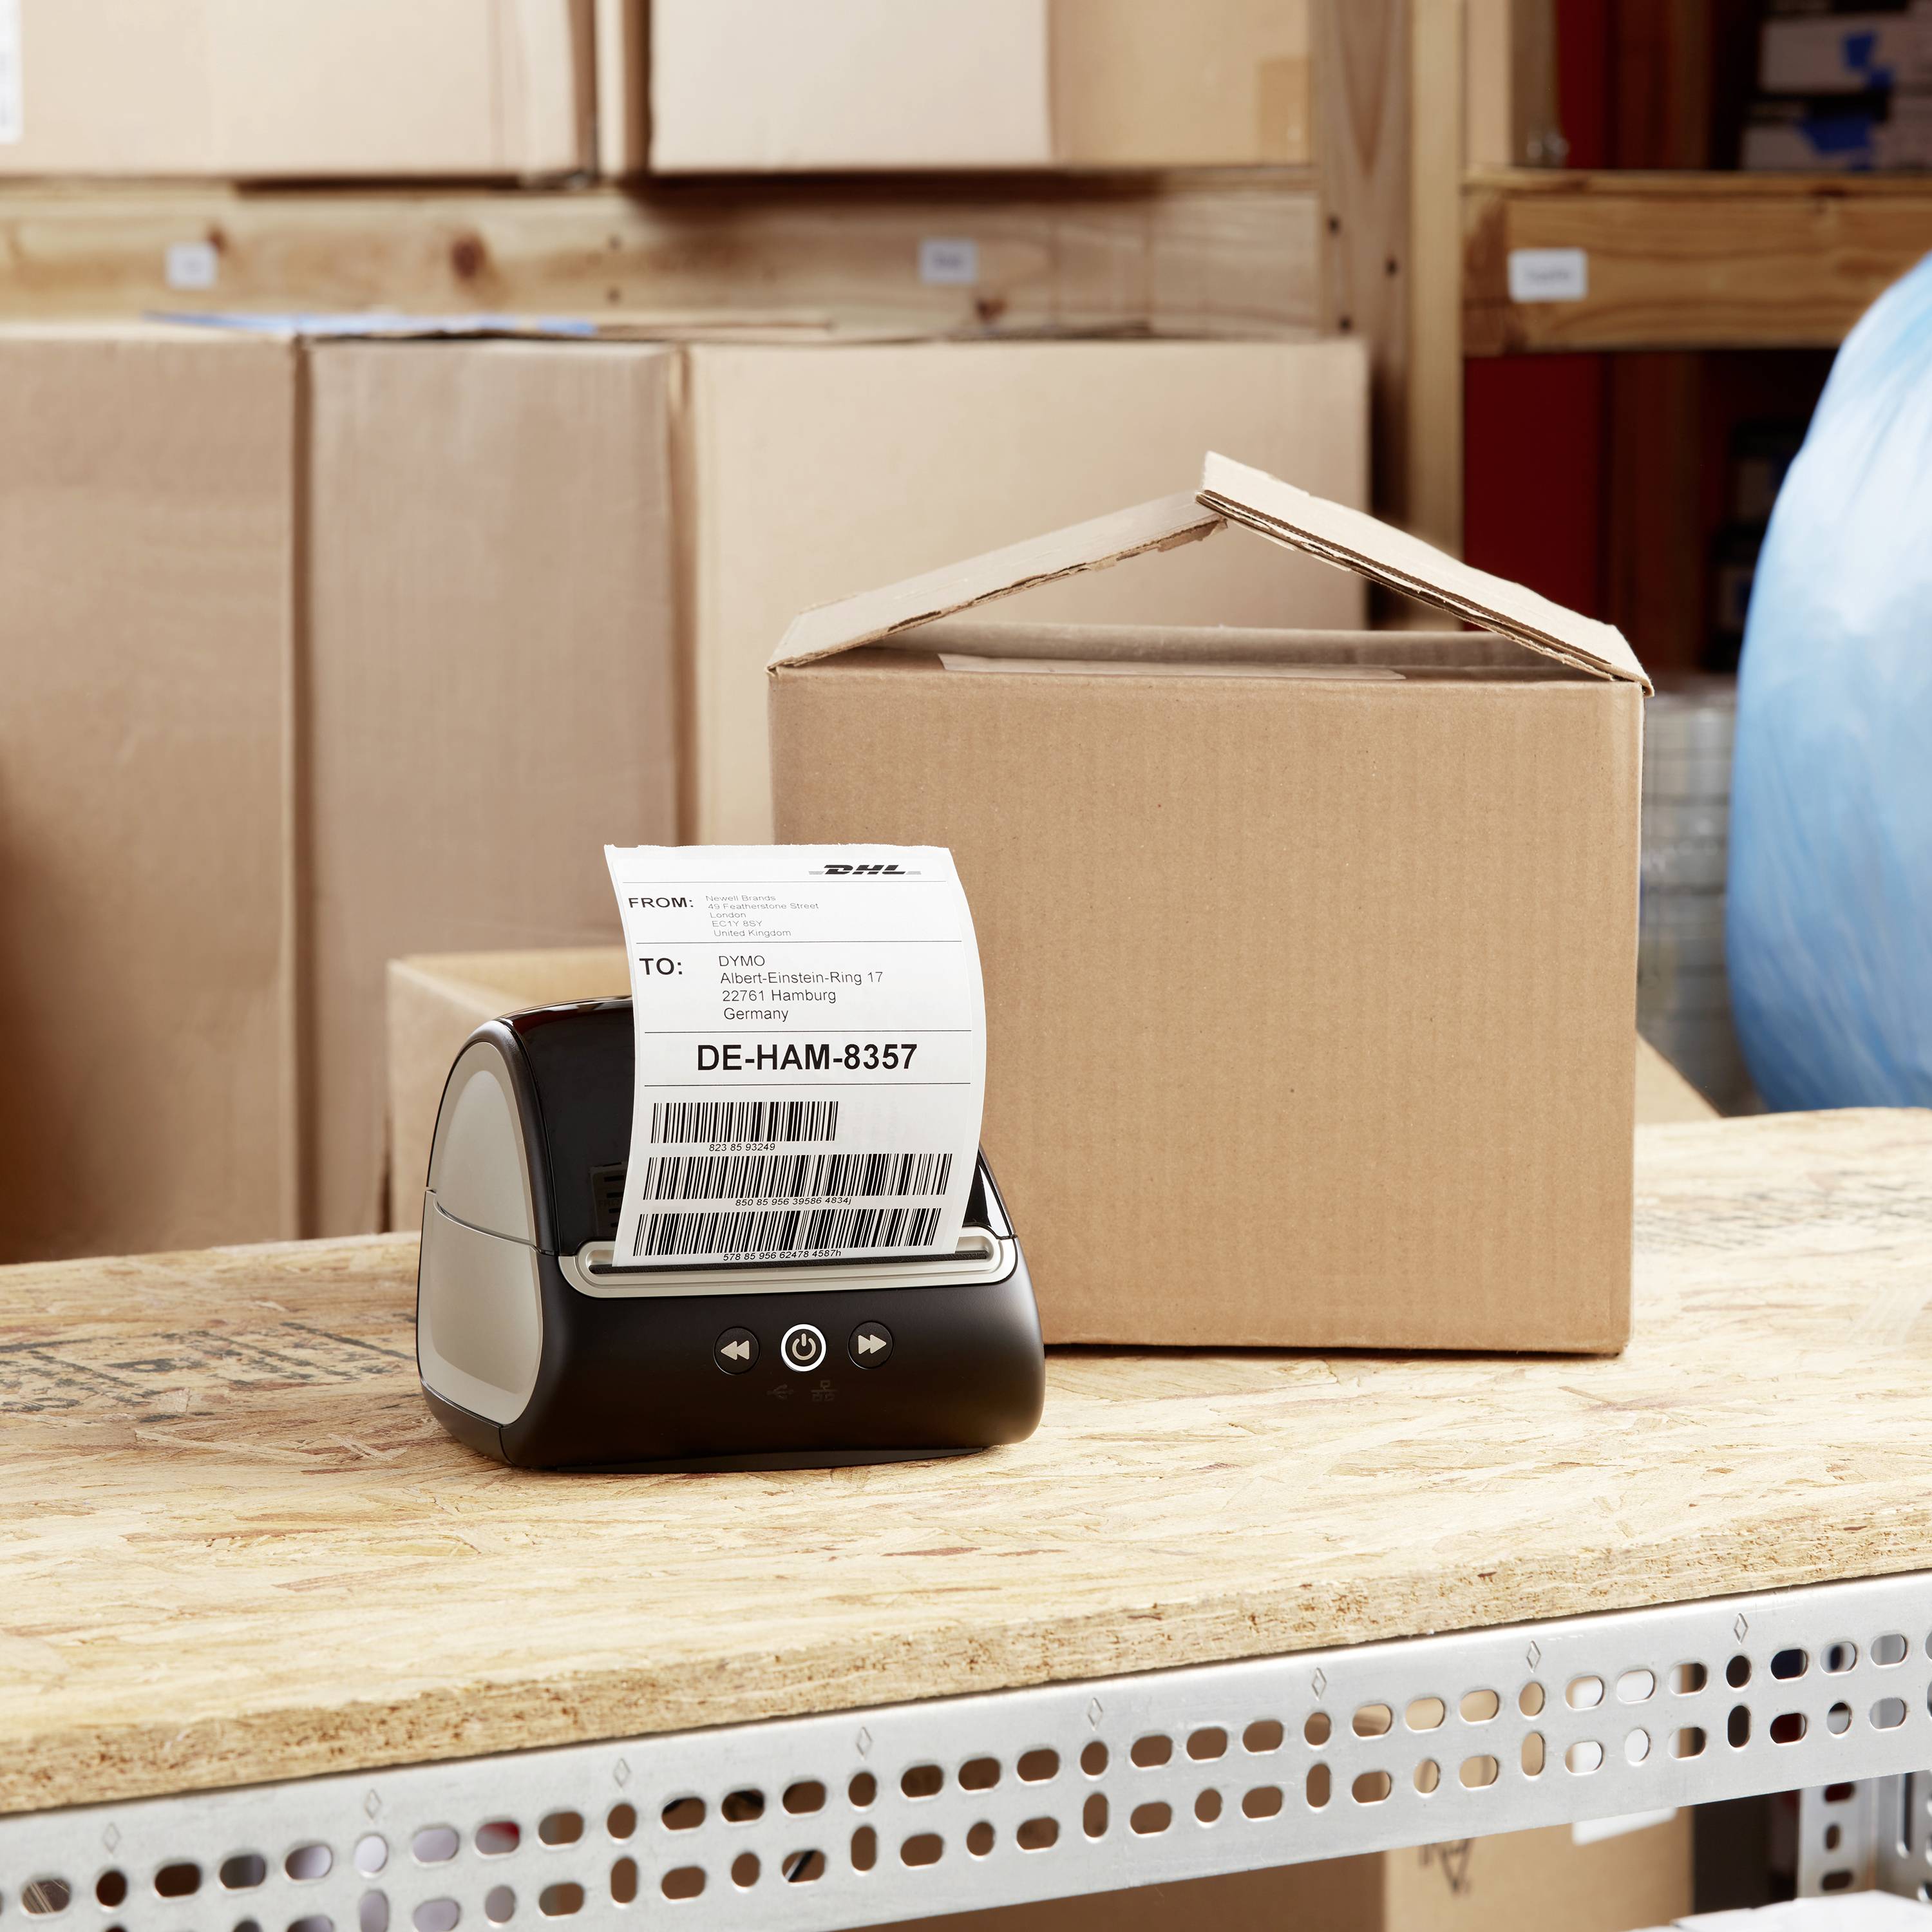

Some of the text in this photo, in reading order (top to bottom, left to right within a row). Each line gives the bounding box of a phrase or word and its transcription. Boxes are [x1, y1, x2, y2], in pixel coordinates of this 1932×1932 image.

[822, 864, 906, 875] DHL
[628, 897, 694, 908] FROM:
[748, 929, 791, 938] Kingdom
[638, 957, 683, 976] TO:
[718, 955, 765, 967] DYMO
[720, 971, 883, 986] Albert-Einstein-Ring 17
[722, 989, 836, 1004] 22761 Hamburg
[723, 1007, 789, 1023] Germany
[697, 1043, 918, 1071] DE-HAM-8357
[708, 1142, 776, 1152] 823 85 93249
